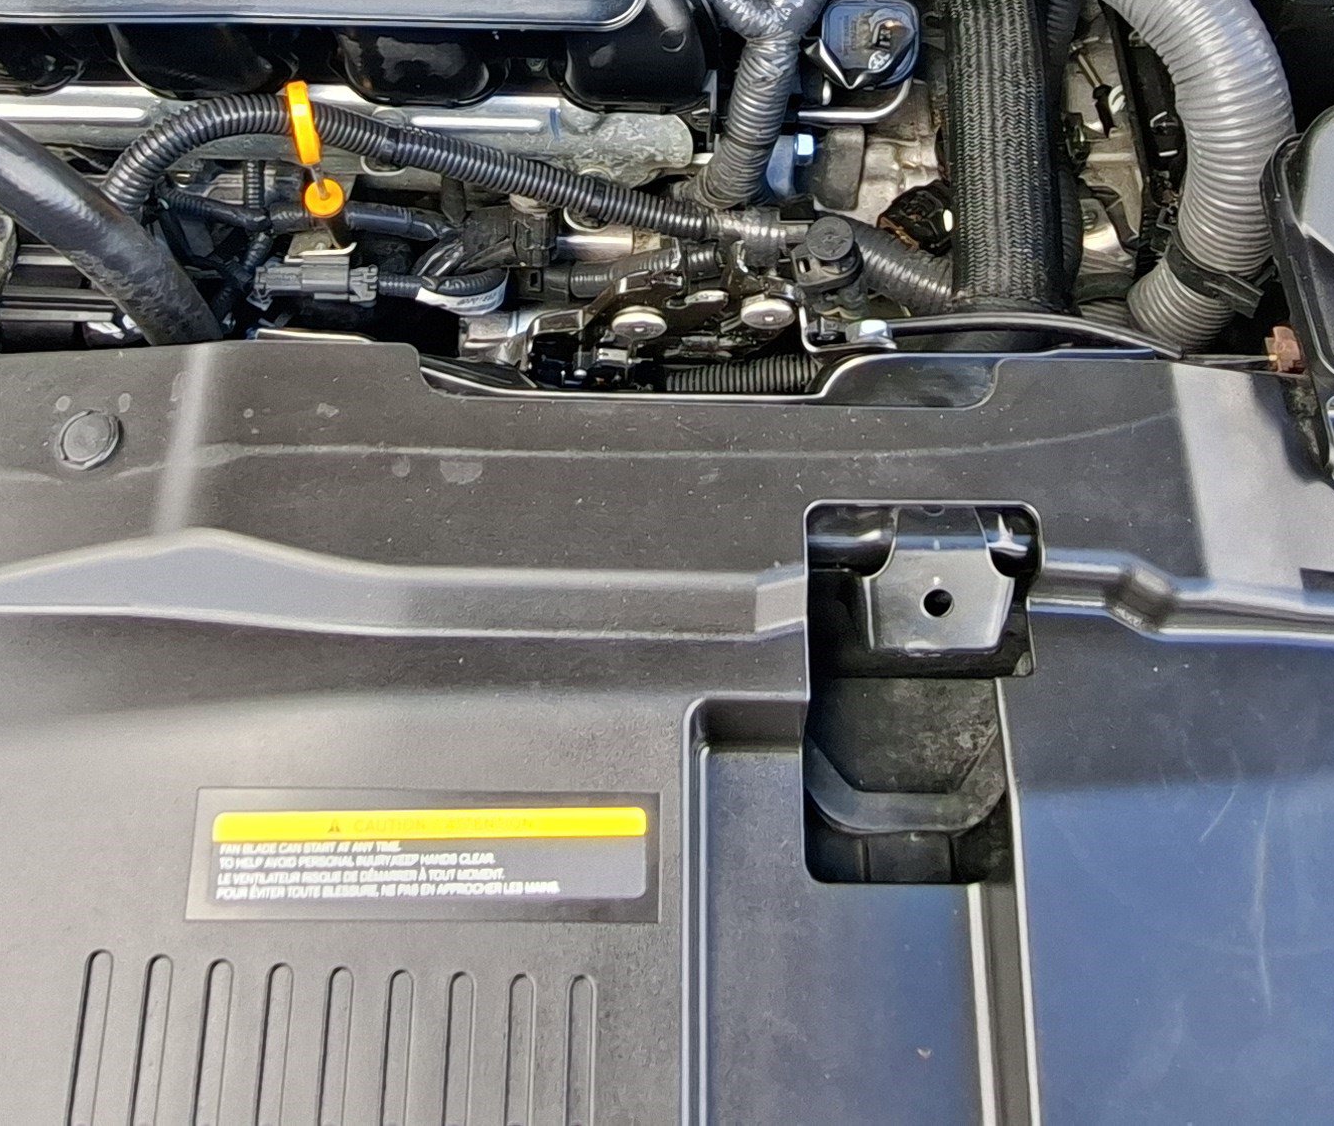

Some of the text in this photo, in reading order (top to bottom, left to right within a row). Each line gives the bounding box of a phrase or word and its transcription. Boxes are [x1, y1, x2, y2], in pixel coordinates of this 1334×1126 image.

[220, 843, 241, 855] FAN
[242, 843, 277, 855] BLADE
[278, 842, 302, 854] CAN
[303, 842, 337, 854] START
[219, 856, 235, 869] TO
[235, 856, 264, 869] HELP
[264, 856, 297, 869] AVOID
[420, 853, 457, 866] HANDS
[217, 872, 232, 885] LE
[233, 871, 301, 885] VENTILATEUR
[301, 871, 342, 884] RISQUE
[342, 870, 358, 883] DE
[428, 868, 456, 881] TOUT
[216, 886, 248, 900] POUR
[248, 882, 286, 900] ÉVITER
[287, 885, 321, 898] TOUTE
[397, 883, 419, 896] PAS
[420, 883, 436, 896] EN
[436, 882, 503, 895] APPROCHER
[503, 881, 523, 895] LES
